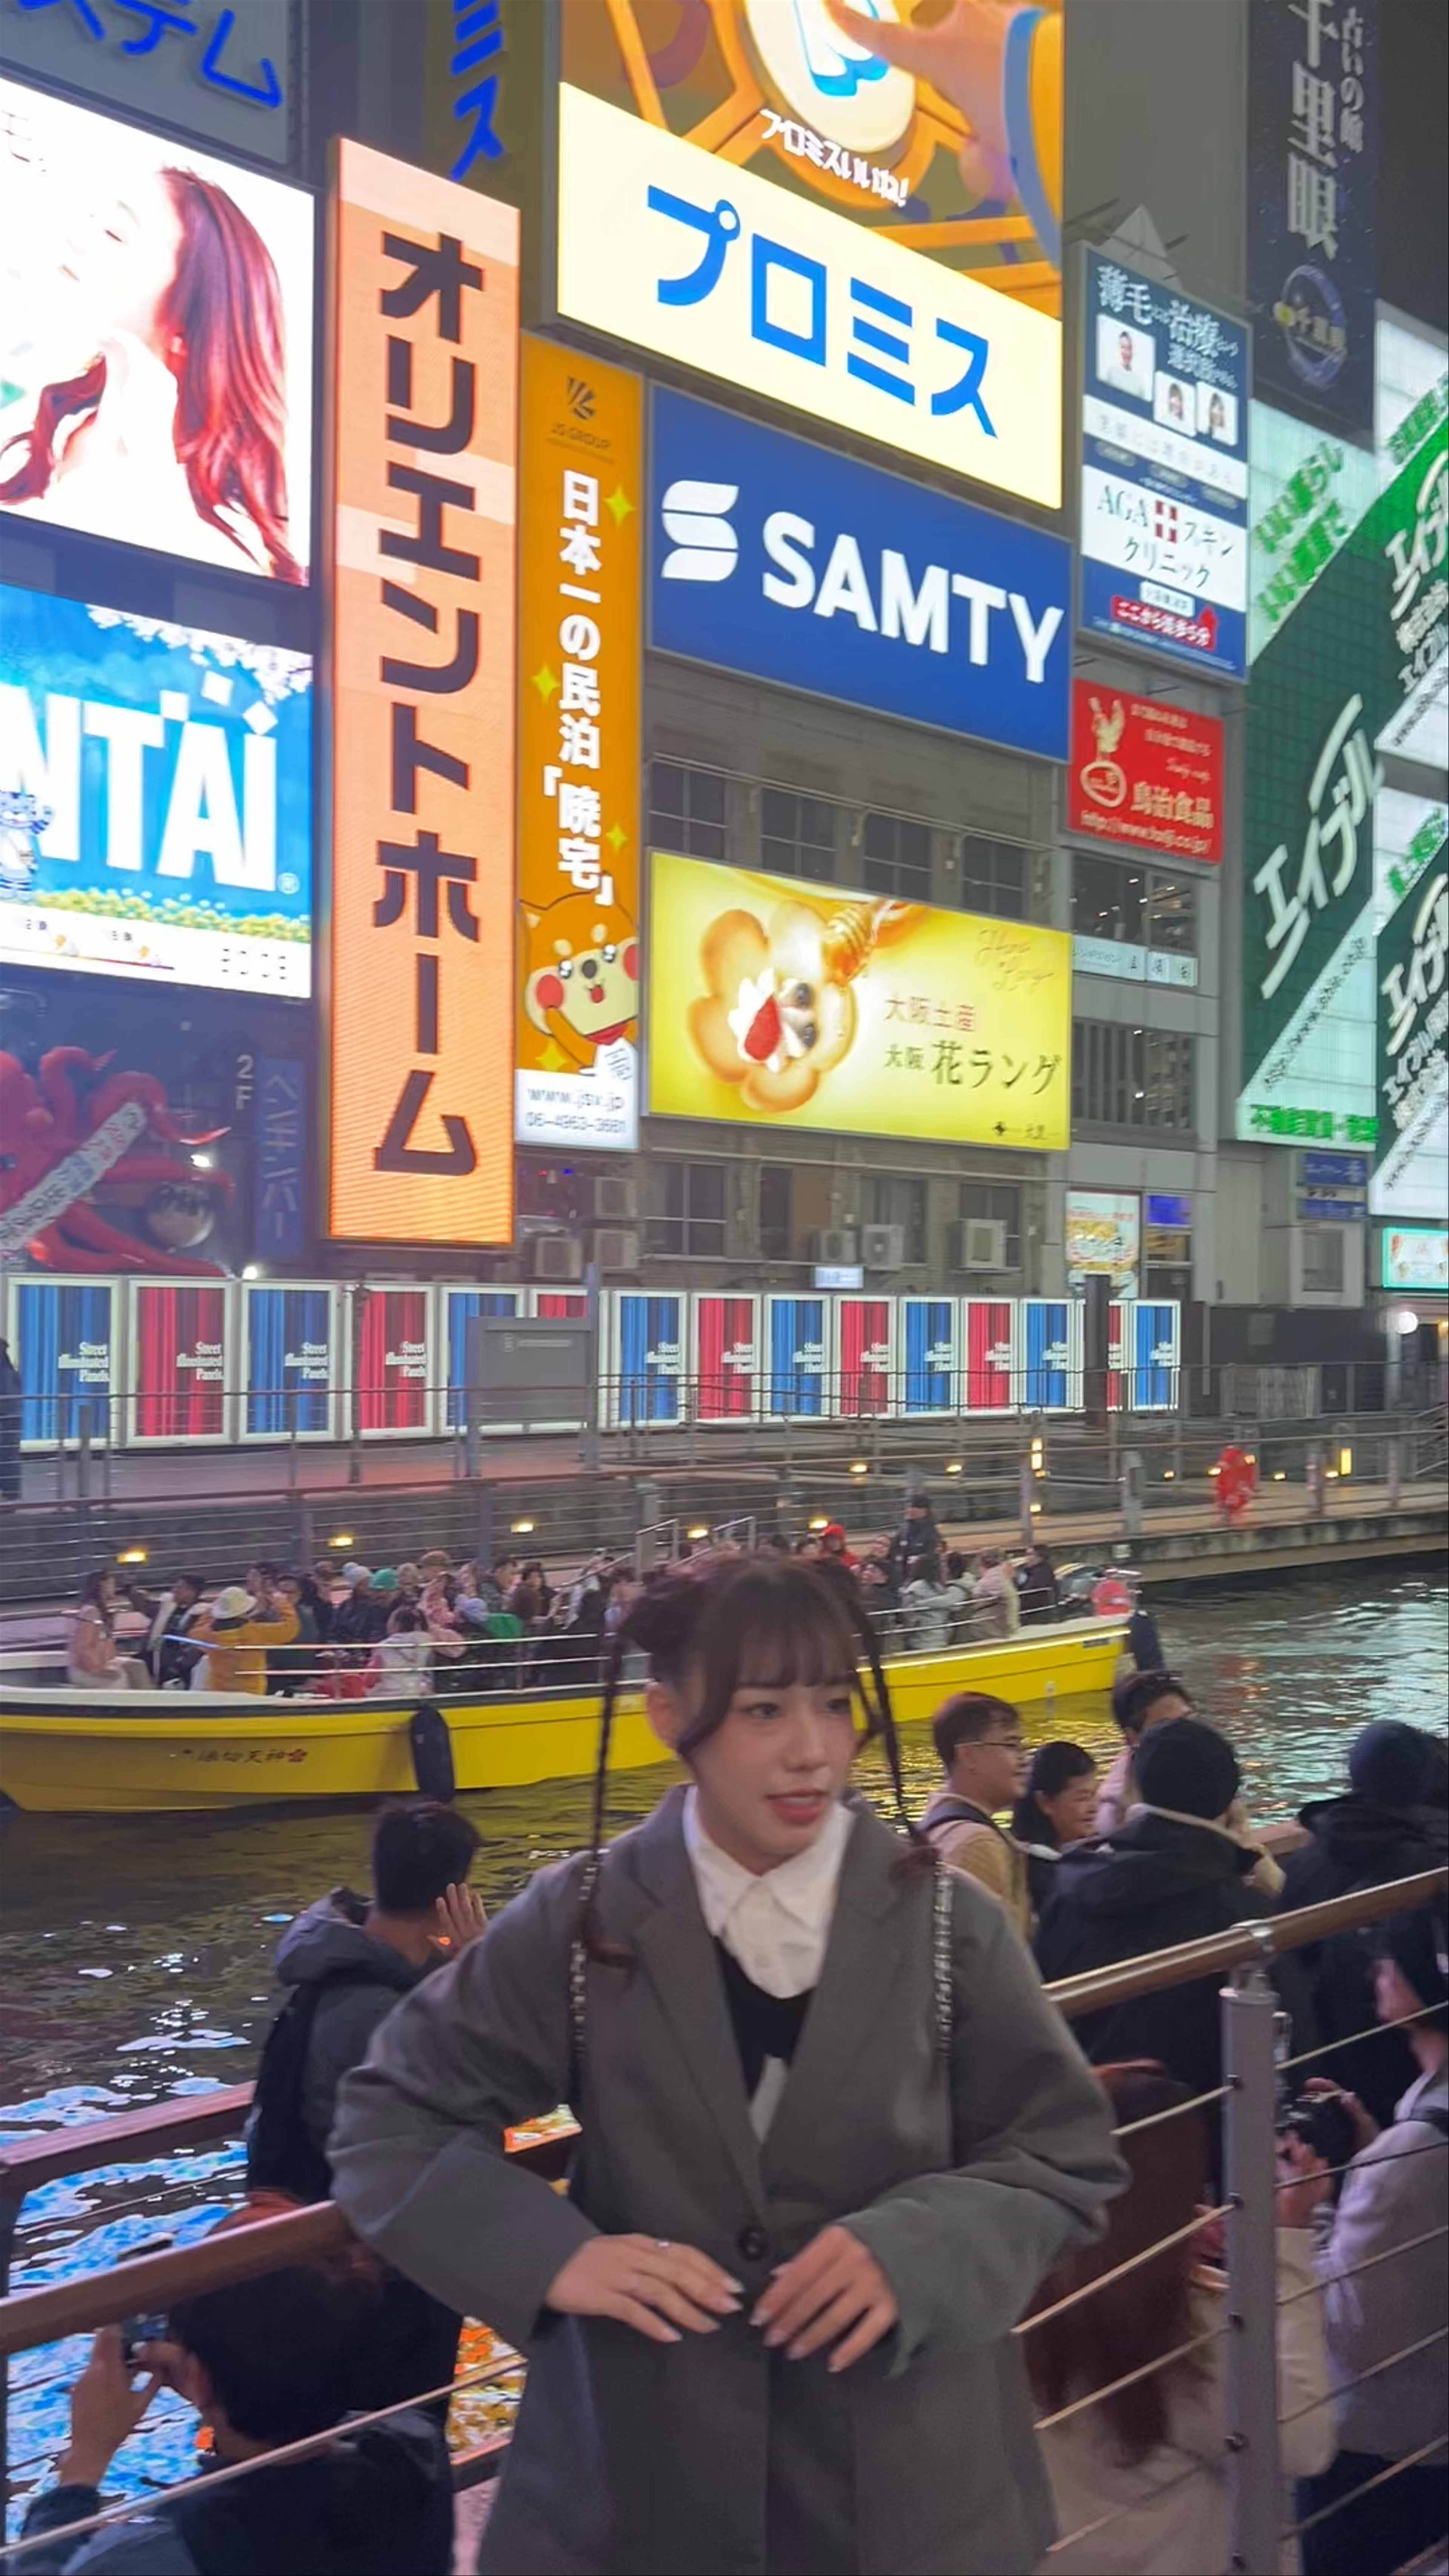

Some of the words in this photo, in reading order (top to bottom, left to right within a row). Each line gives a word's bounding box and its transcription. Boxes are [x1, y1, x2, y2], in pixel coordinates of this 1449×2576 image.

[648, 185, 998, 439] プロミス
[762, 511, 1065, 684] SAMTY
[1123, 536, 1211, 589] クリニック
[372, 231, 485, 1177] オリエントホーム
[1254, 693, 1385, 1001] エイブル
